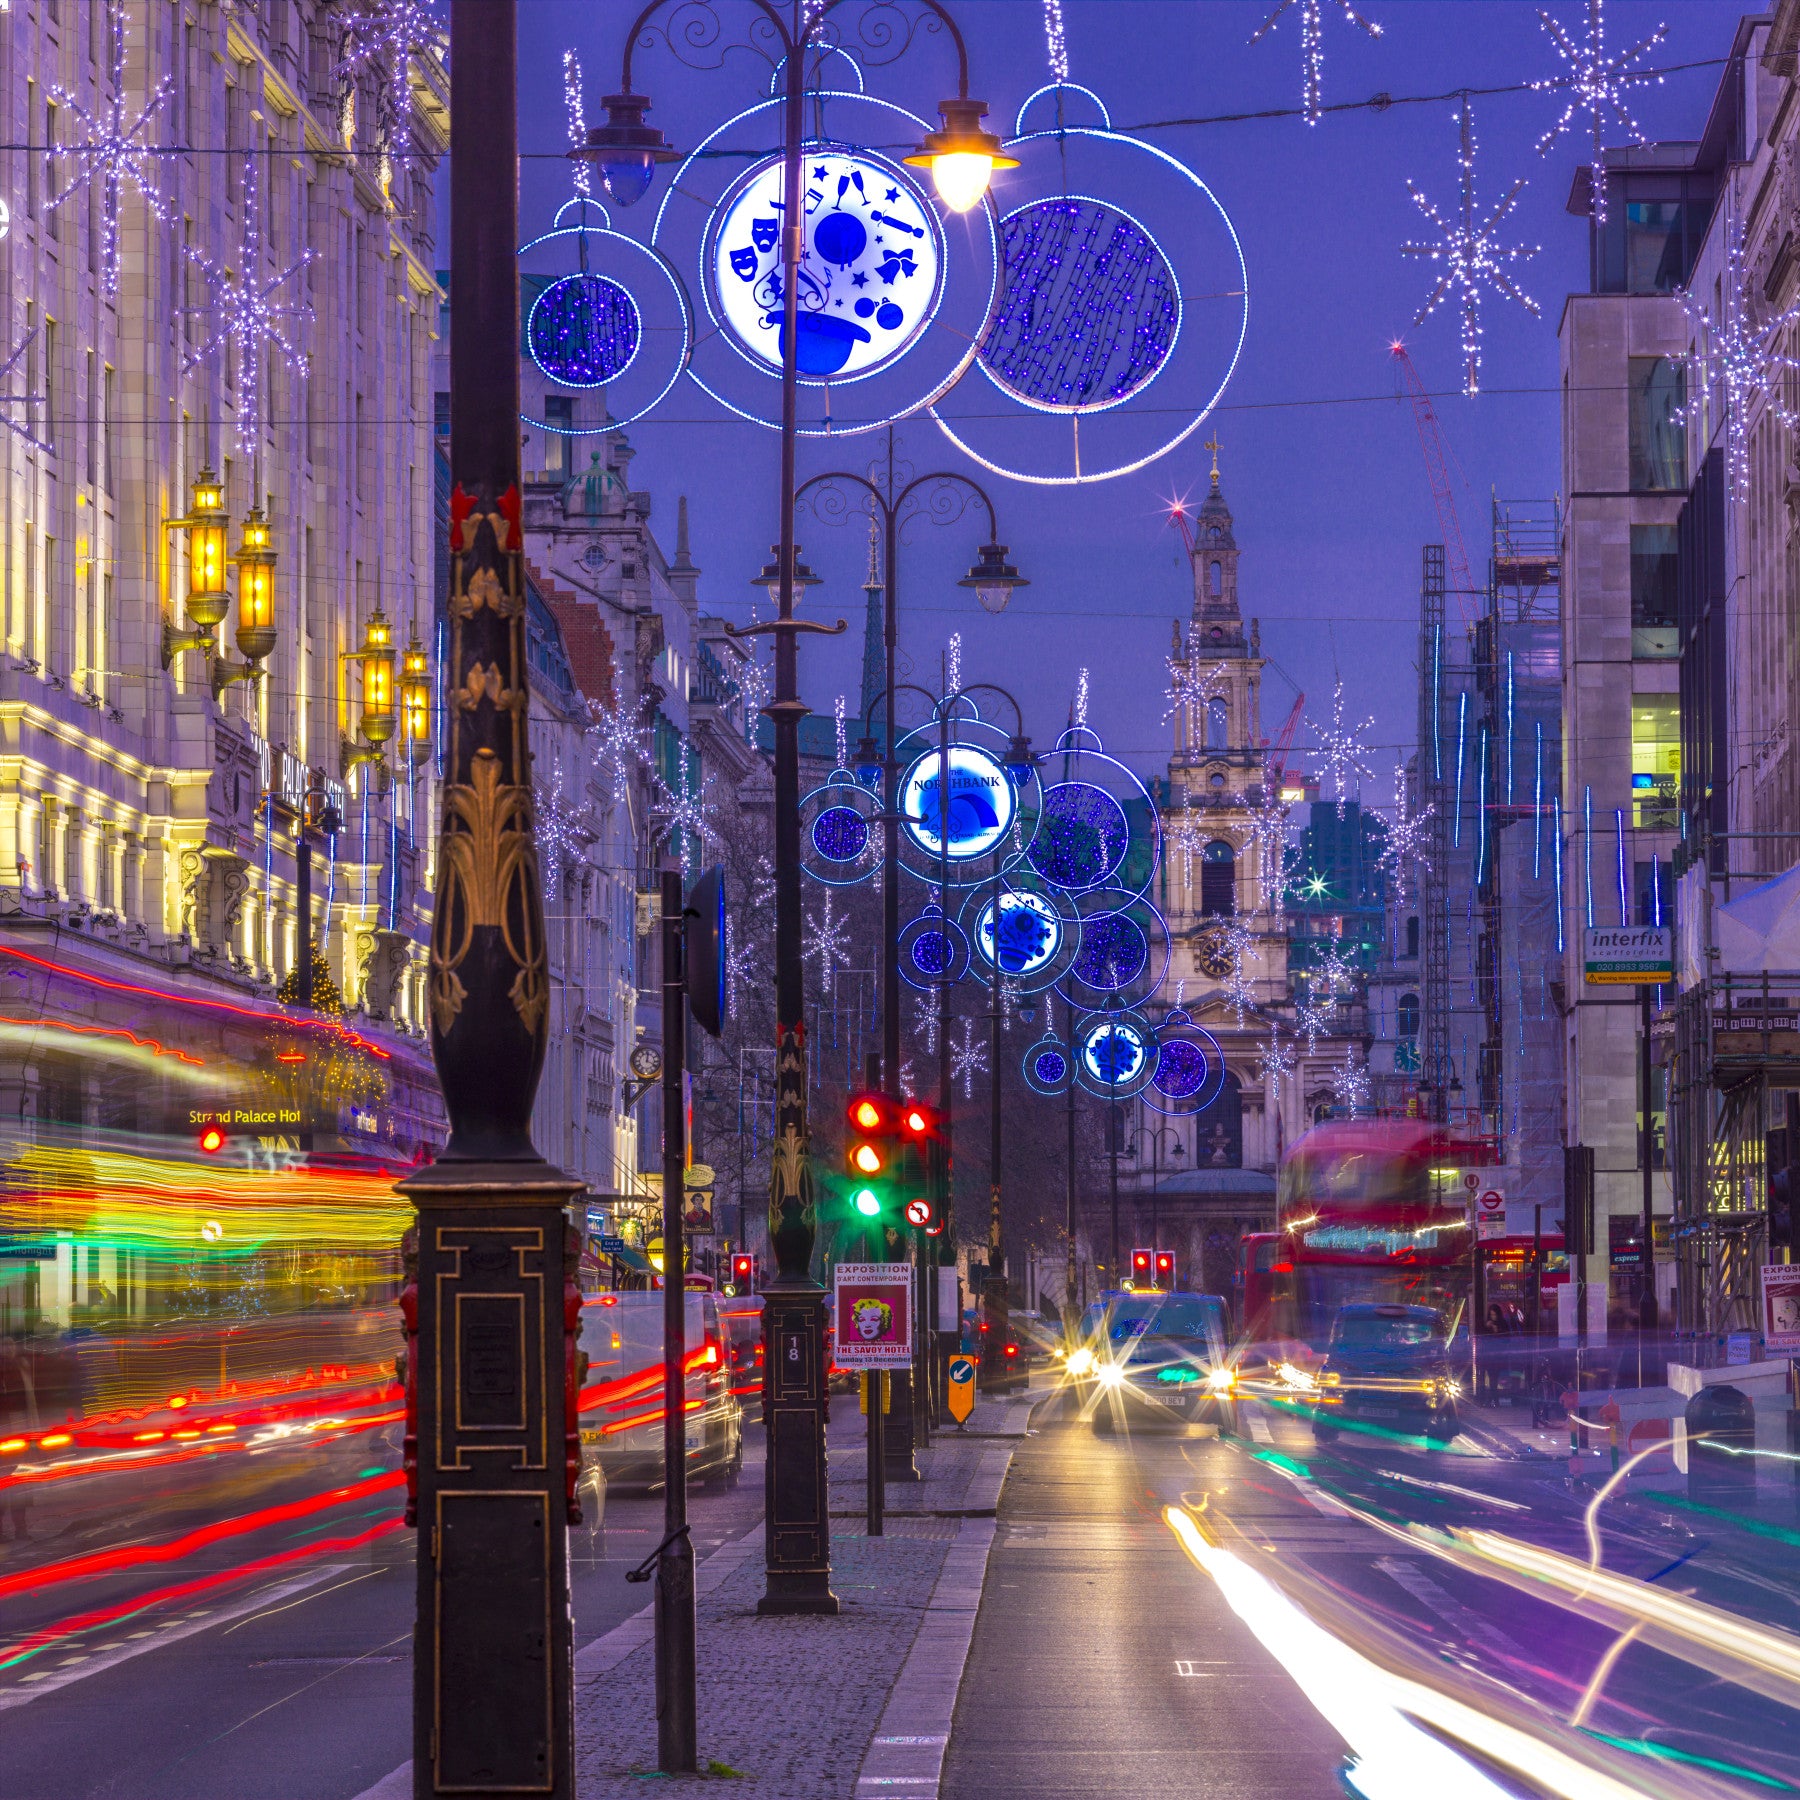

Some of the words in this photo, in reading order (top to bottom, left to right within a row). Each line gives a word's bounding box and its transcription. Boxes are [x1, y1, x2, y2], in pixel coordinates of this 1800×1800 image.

[914, 776, 1000, 791] NORHBANK
[1592, 931, 1664, 947] interfix
[1592, 949, 1664, 957] scaffolding
[1596, 963, 1613, 971] 020
[1615, 963, 1636, 971] 8953
[1638, 963, 1660, 971] 9567
[235, 1109, 276, 1123] Palace
[280, 1108, 301, 1122] Hot
[1614, 1255, 1640, 1263] express
[837, 1265, 909, 1274] EXPOSITION
[837, 1346, 852, 1354] THE
[854, 1346, 883, 1354] SAVOY
[884, 1346, 911, 1354] HOTEL
